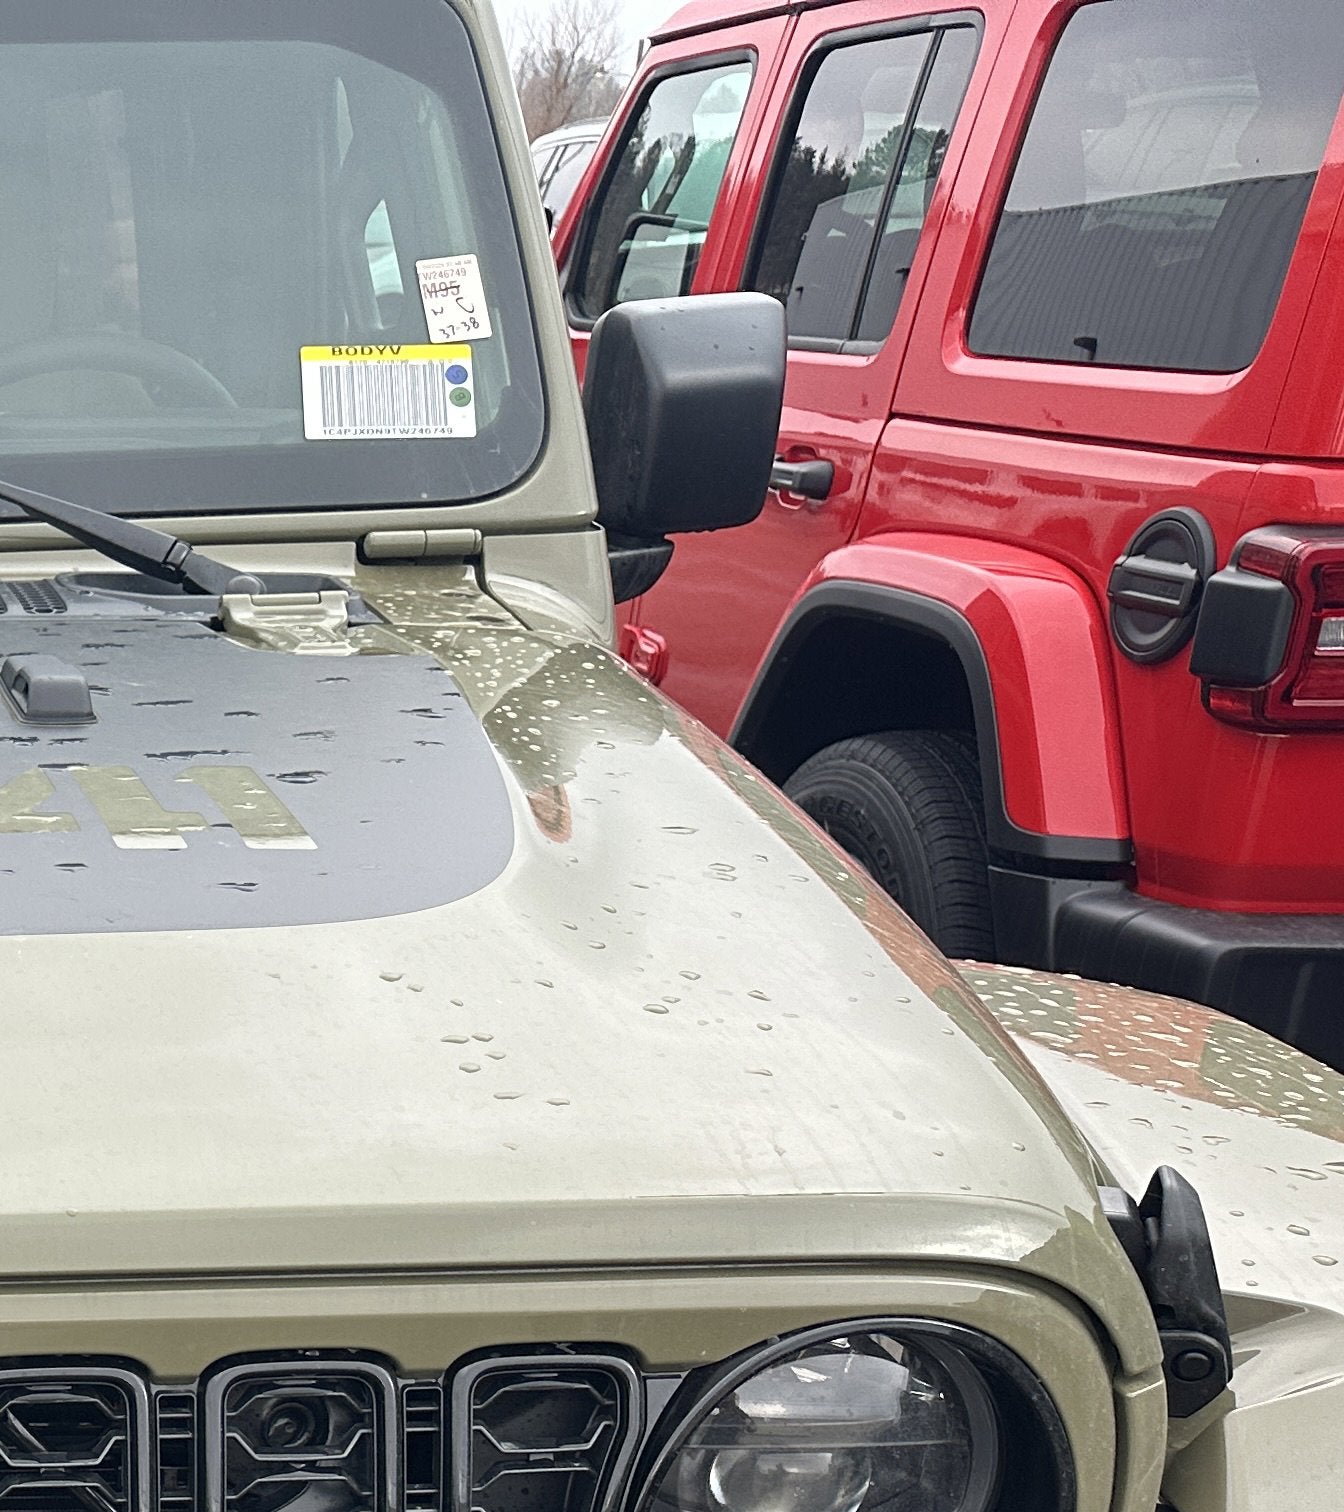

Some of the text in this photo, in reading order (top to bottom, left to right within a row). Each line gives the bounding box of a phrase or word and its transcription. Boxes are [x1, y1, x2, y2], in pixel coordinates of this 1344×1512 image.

[422, 280, 460, 299] M95
[438, 316, 480, 339] 37-38
[331, 345, 402, 356] BODYV
